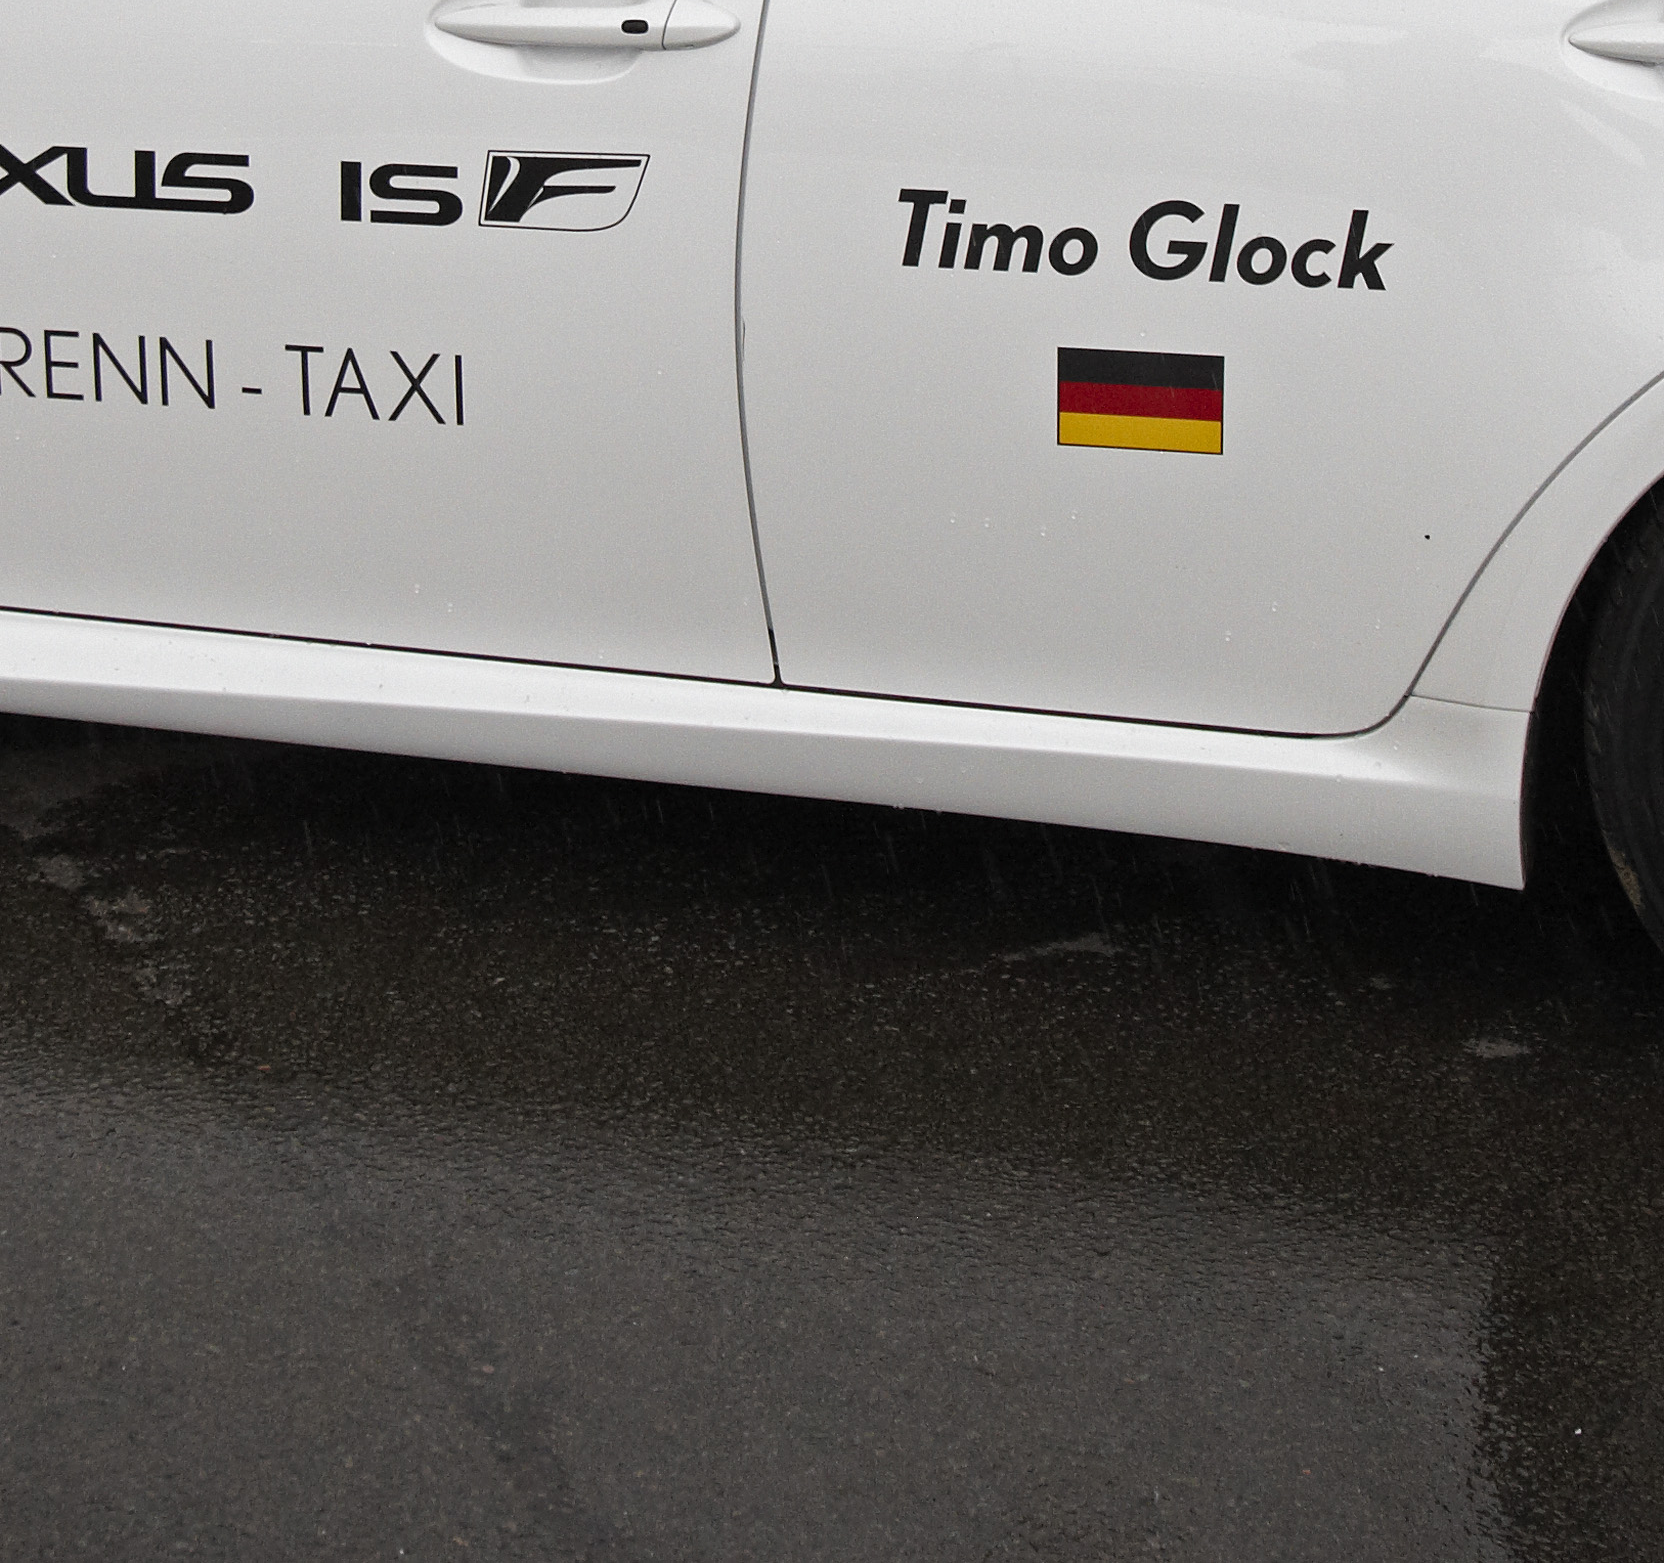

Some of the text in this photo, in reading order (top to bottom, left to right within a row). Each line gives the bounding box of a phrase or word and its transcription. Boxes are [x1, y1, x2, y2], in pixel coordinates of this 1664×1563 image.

[338, 158, 463, 228] IS
[898, 188, 1395, 291] Timo Glock
[285, 343, 466, 428] TAXI
